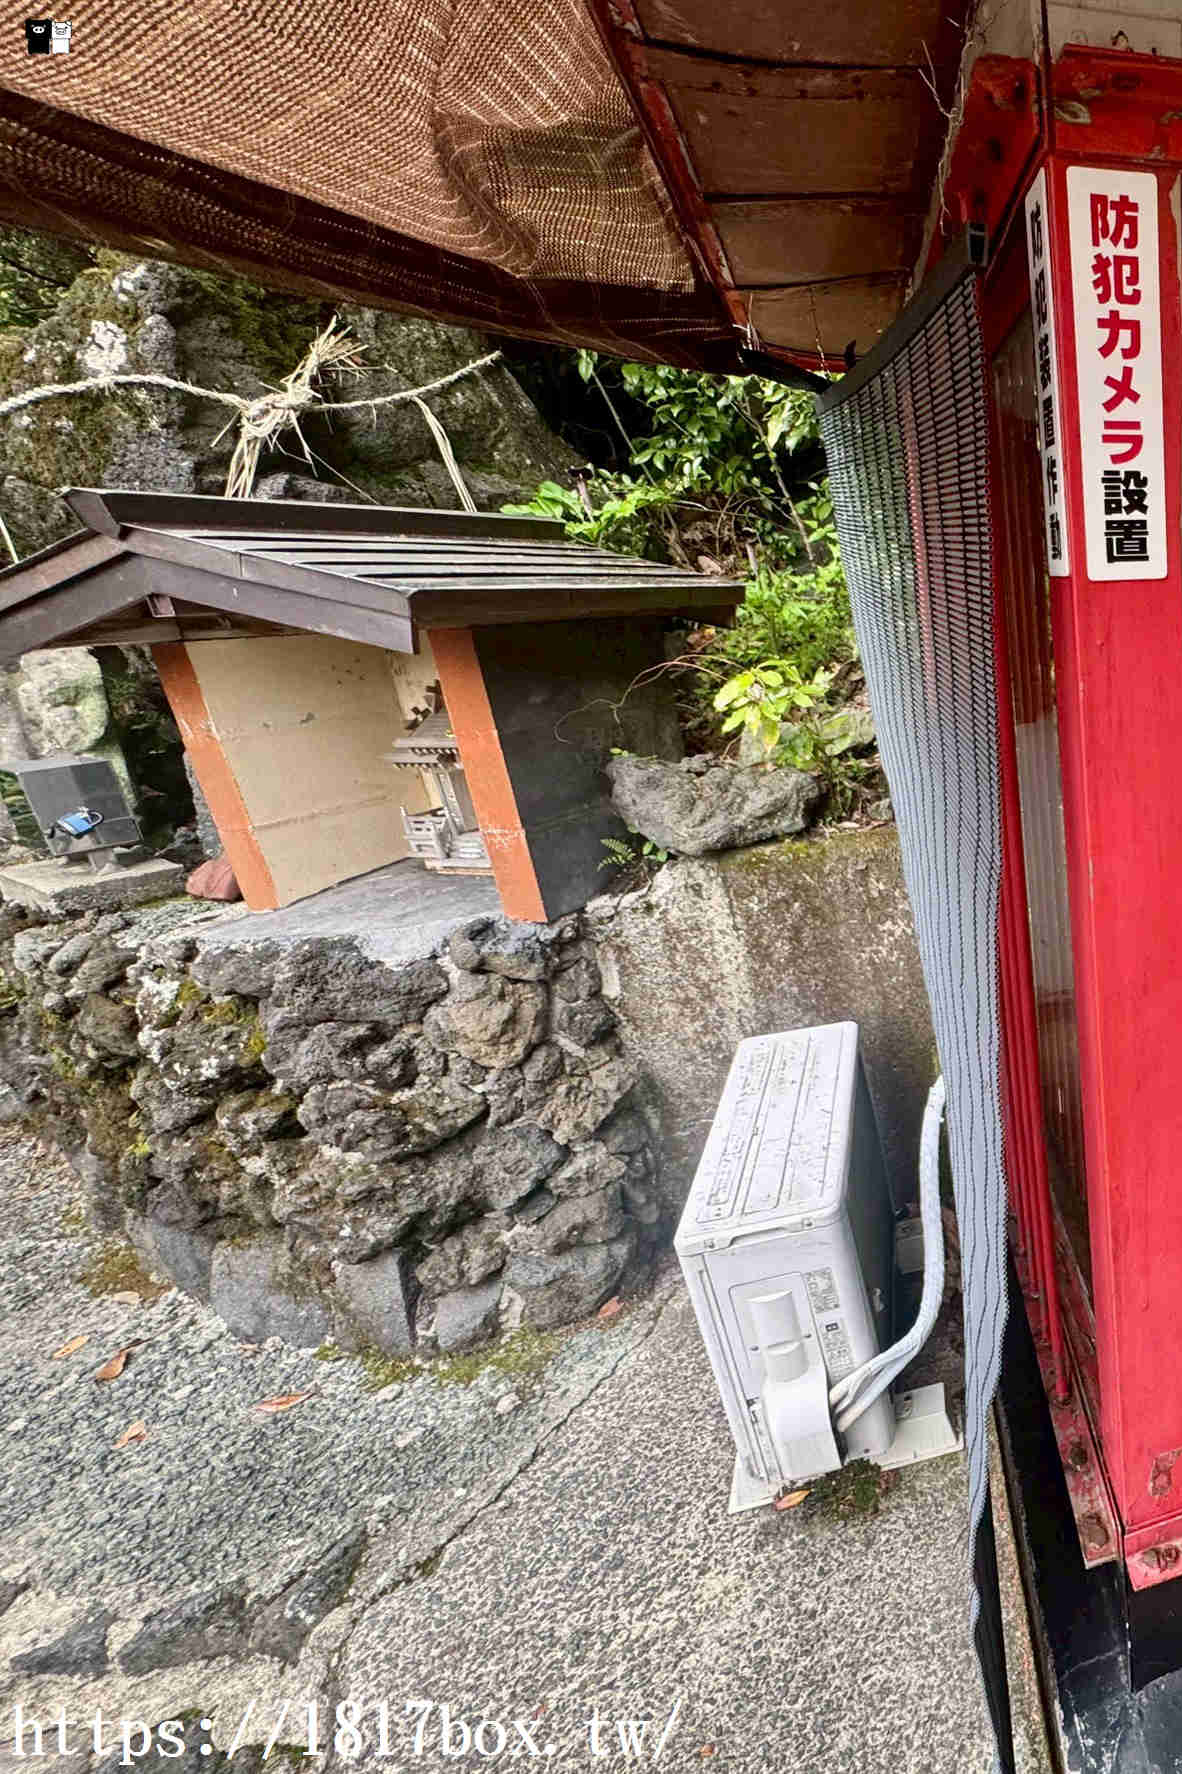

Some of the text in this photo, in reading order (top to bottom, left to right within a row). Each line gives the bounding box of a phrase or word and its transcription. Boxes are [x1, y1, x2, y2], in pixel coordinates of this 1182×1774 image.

[1089, 192, 1150, 564] 防犯カメラ設置
